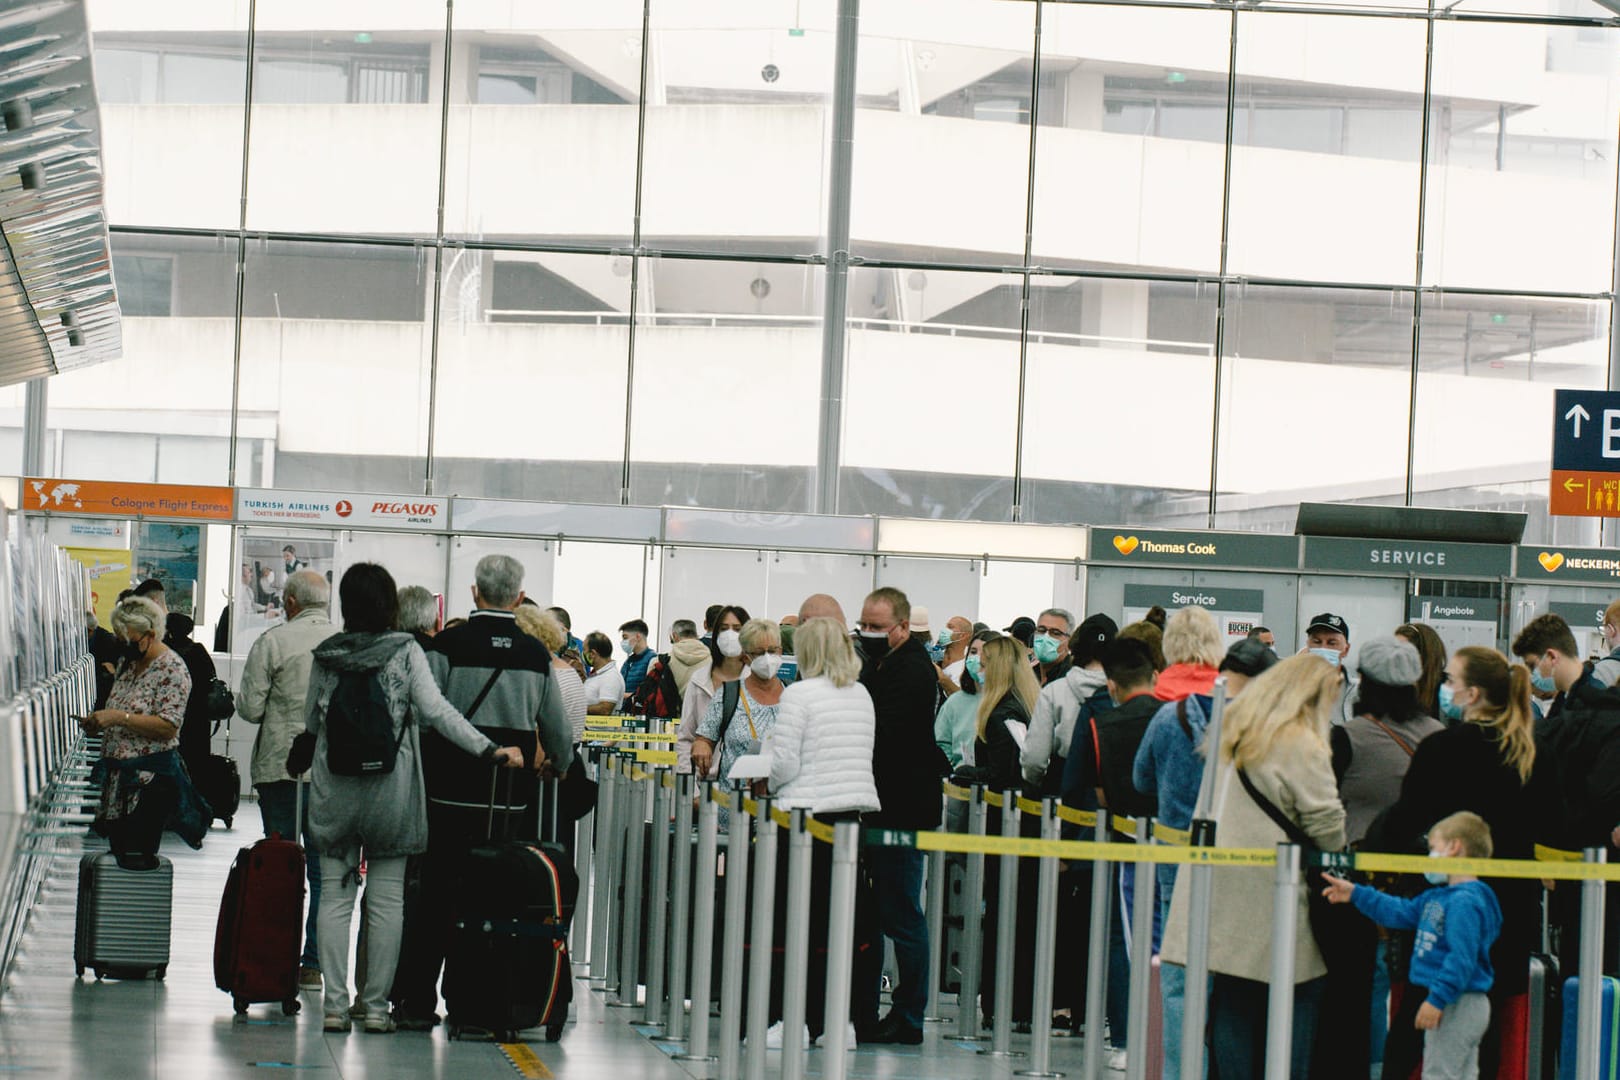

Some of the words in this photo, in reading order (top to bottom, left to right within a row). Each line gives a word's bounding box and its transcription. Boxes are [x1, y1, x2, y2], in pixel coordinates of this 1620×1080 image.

[1604, 480, 1618, 490] WC
[111, 496, 155, 511] Cologne
[159, 499, 188, 512] Flight
[191, 500, 229, 513] Express
[244, 500, 284, 509] TURKISH
[289, 503, 330, 511] AIRLINES
[371, 502, 438, 516] PEGASUS
[1140, 540, 1185, 554] Thomas
[1187, 542, 1216, 555] Cook
[1370, 549, 1446, 566] SERVICE
[1566, 558, 1620, 570] NECKERM
[1172, 592, 1216, 606] Service
[1433, 605, 1475, 617] Angebote
